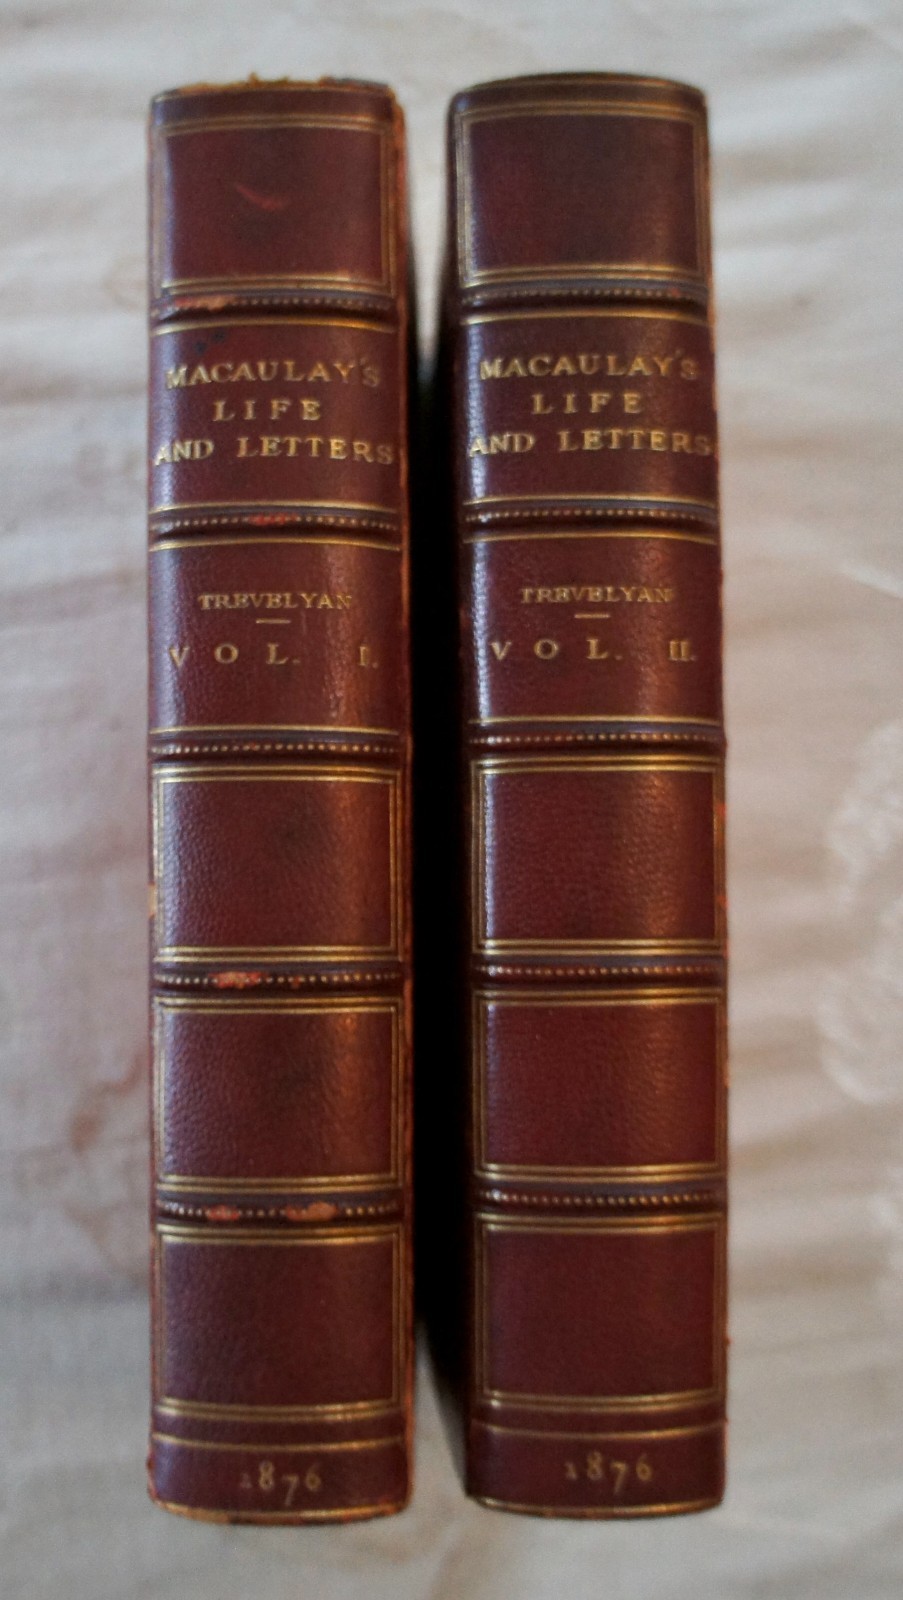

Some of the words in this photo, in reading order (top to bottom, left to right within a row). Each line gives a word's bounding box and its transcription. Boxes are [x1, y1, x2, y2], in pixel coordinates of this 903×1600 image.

[165, 357, 380, 389] MACAULAY'S
[479, 350, 698, 380] MACAULAY'S
[212, 399, 322, 422] LIFE
[531, 392, 643, 414] LIFE
[154, 439, 215, 466] AND
[236, 436, 394, 465] LETTERS
[469, 431, 536, 457] AND
[557, 429, 712, 456] LETTERS
[199, 592, 353, 611] TREVELYAN
[520, 586, 673, 604] TREVELYAN
[240, 1460, 322, 1507] 1876
[564, 1449, 653, 1496] 1876
